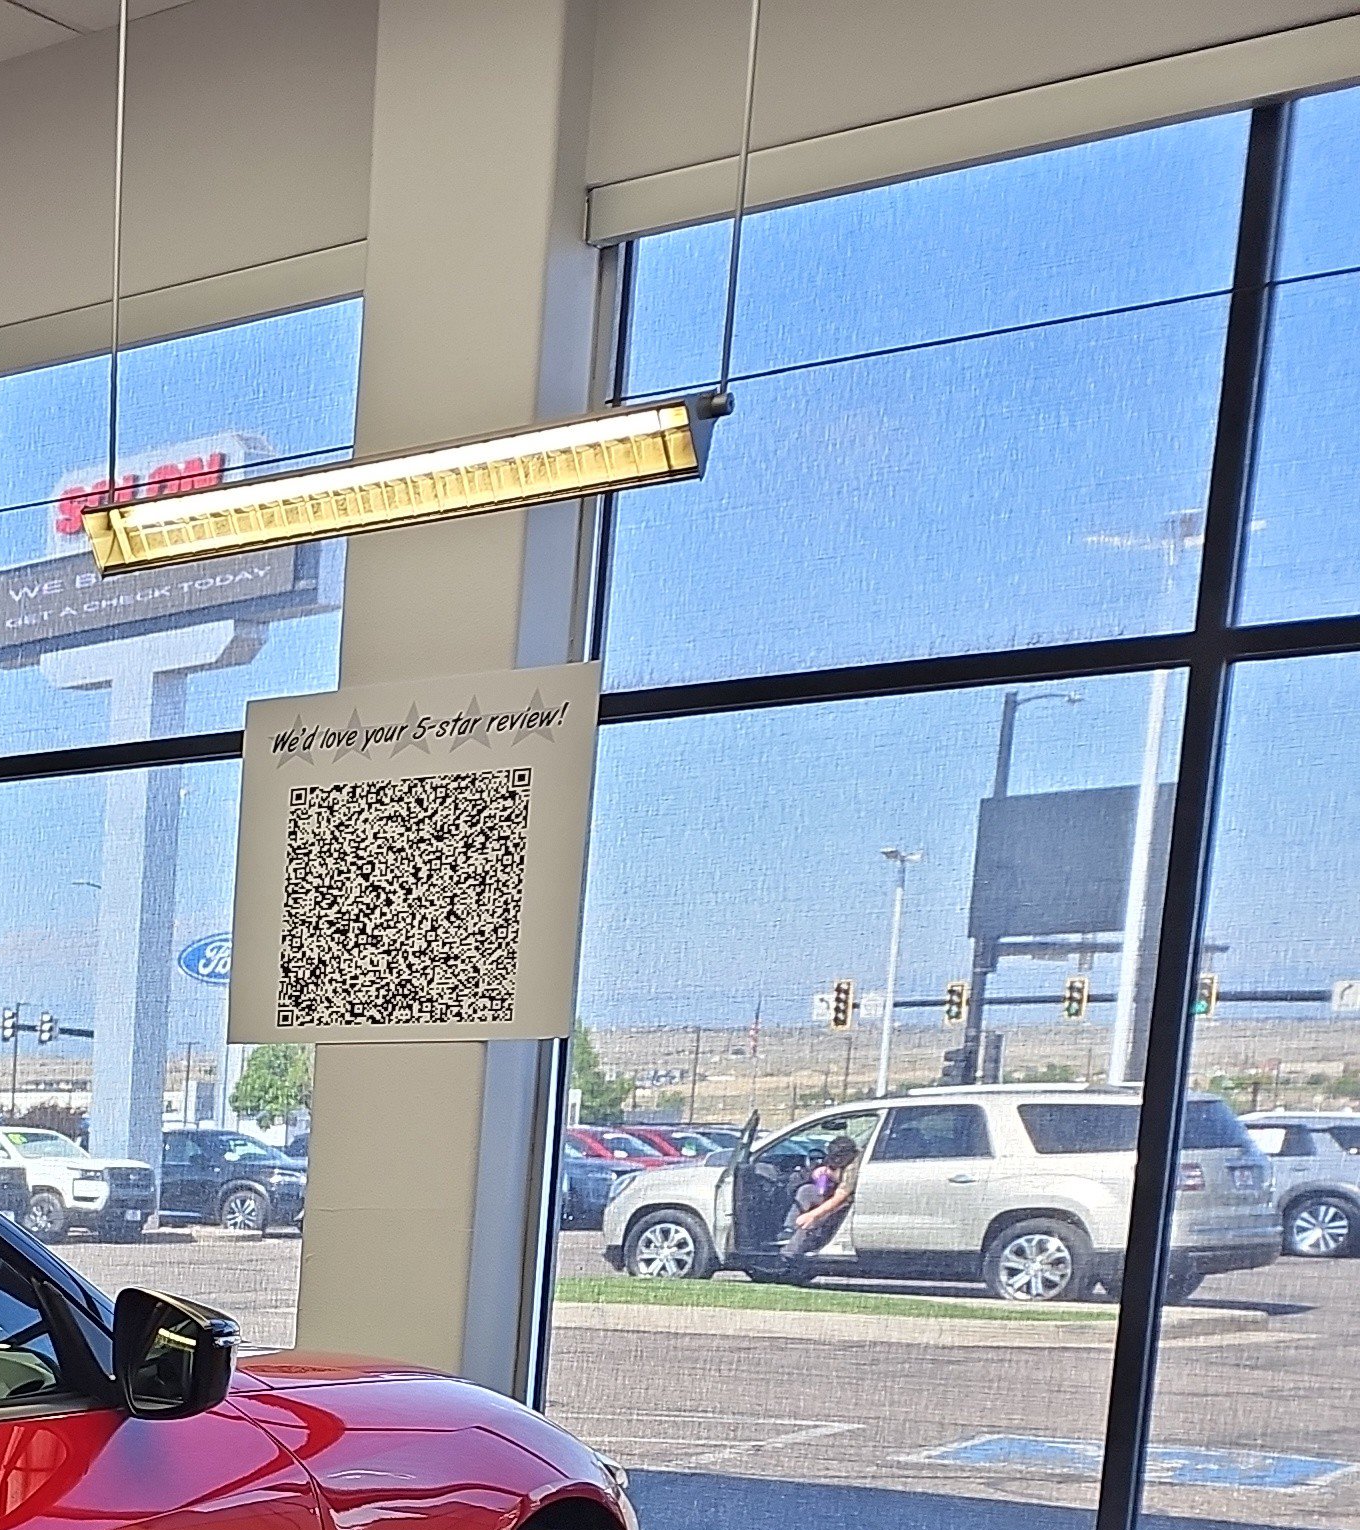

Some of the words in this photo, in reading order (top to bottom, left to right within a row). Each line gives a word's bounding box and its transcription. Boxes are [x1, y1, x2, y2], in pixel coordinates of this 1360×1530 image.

[6, 607, 54, 629] GET
[59, 604, 78, 617] A
[83, 585, 172, 613] CHECK
[180, 566, 271, 592] TODAY
[9, 579, 64, 602] WE
[272, 725, 320, 754] We'd
[320, 727, 358, 751] love
[361, 724, 408, 752] your
[413, 711, 482, 740] 5-star
[486, 701, 570, 733] review!
